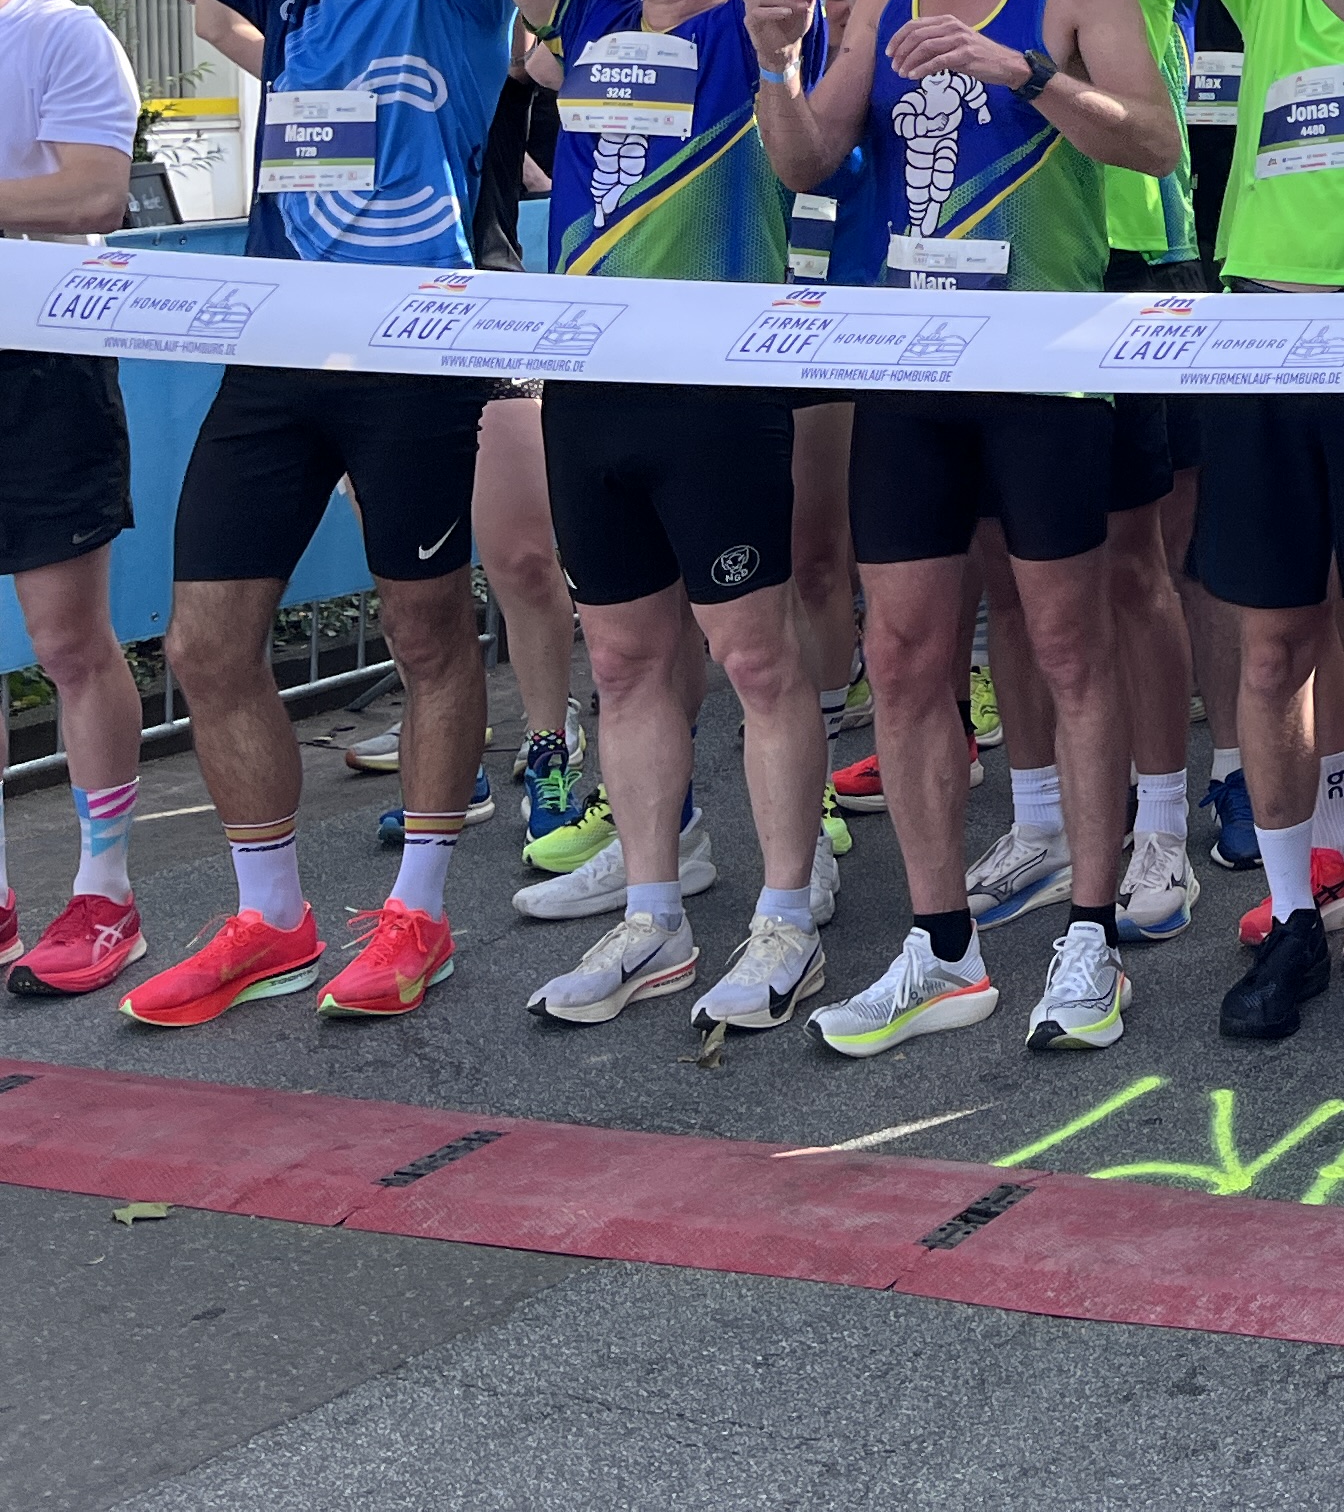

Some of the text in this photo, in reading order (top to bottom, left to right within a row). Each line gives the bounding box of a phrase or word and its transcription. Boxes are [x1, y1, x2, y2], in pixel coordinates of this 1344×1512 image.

[590, 64, 657, 85] Sascha
[1195, 75, 1222, 89] Max
[606, 87, 632, 99] 3242
[1286, 102, 1340, 123] Jonas
[285, 124, 334, 143] Marco
[64, 275, 134, 293] FIRMEN
[786, 288, 828, 300] dm
[1153, 296, 1196, 308] dm
[48, 292, 119, 321] LAUF
[129, 297, 197, 313] HOMBURG
[402, 299, 477, 316] FIRMEN
[382, 316, 460, 341] LAUF
[473, 318, 545, 333] HOMBURG
[758, 316, 834, 331] FIRMEN
[1131, 325, 1208, 338] FIRMEN
[740, 333, 820, 355] LAUF
[833, 333, 907, 346] HOMBURG
[1211, 339, 1288, 350] HOMBURG
[1113, 340, 1197, 361] LAUF
[800, 367, 953, 383] WWW.FIRMENLAUF-HOMBURG.DE
[1180, 372, 1342, 385] WWW.FIRMENLAUF-HOMBURG.DE
